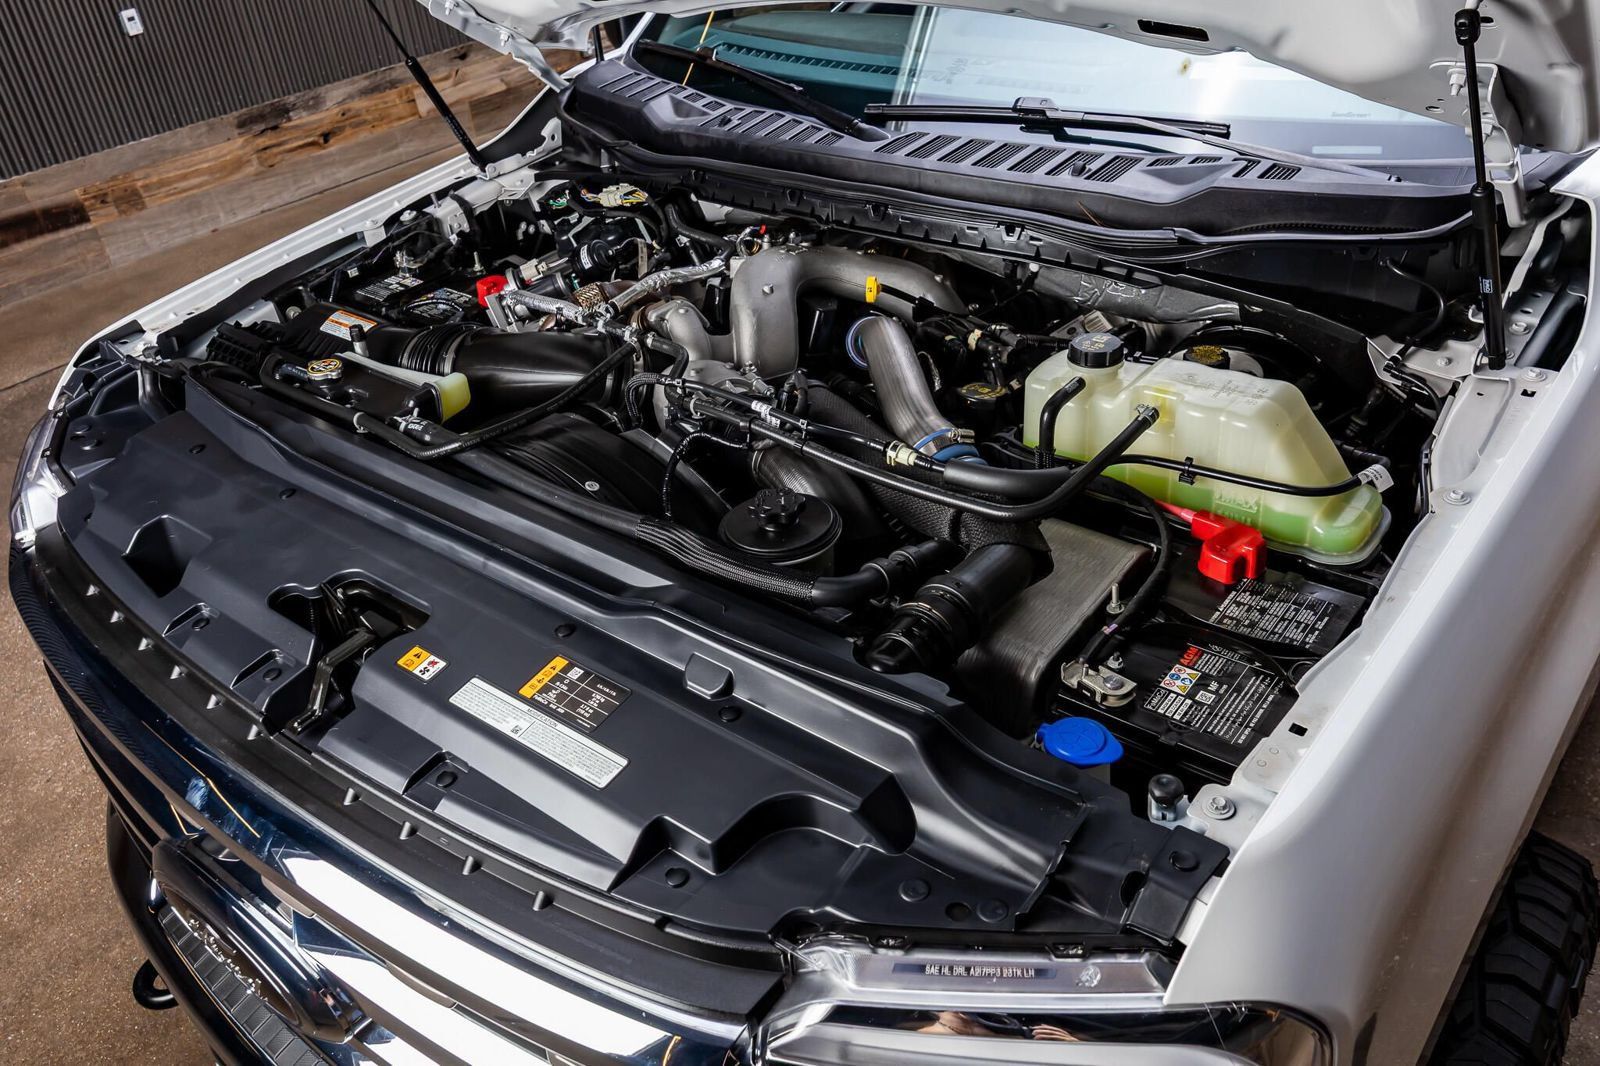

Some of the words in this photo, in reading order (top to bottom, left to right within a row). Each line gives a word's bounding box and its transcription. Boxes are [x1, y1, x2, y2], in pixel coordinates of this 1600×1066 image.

[1179, 646, 1199, 666] AGM
[1208, 680, 1221, 691] MF
[1147, 688, 1165, 709] FoMoCo
[527, 708, 559, 728] MODIFICATION
[925, 964, 939, 975] SAE
[941, 965, 951, 976] HL
[953, 966, 968, 976] DRL
[1023, 968, 1035, 978] LH
